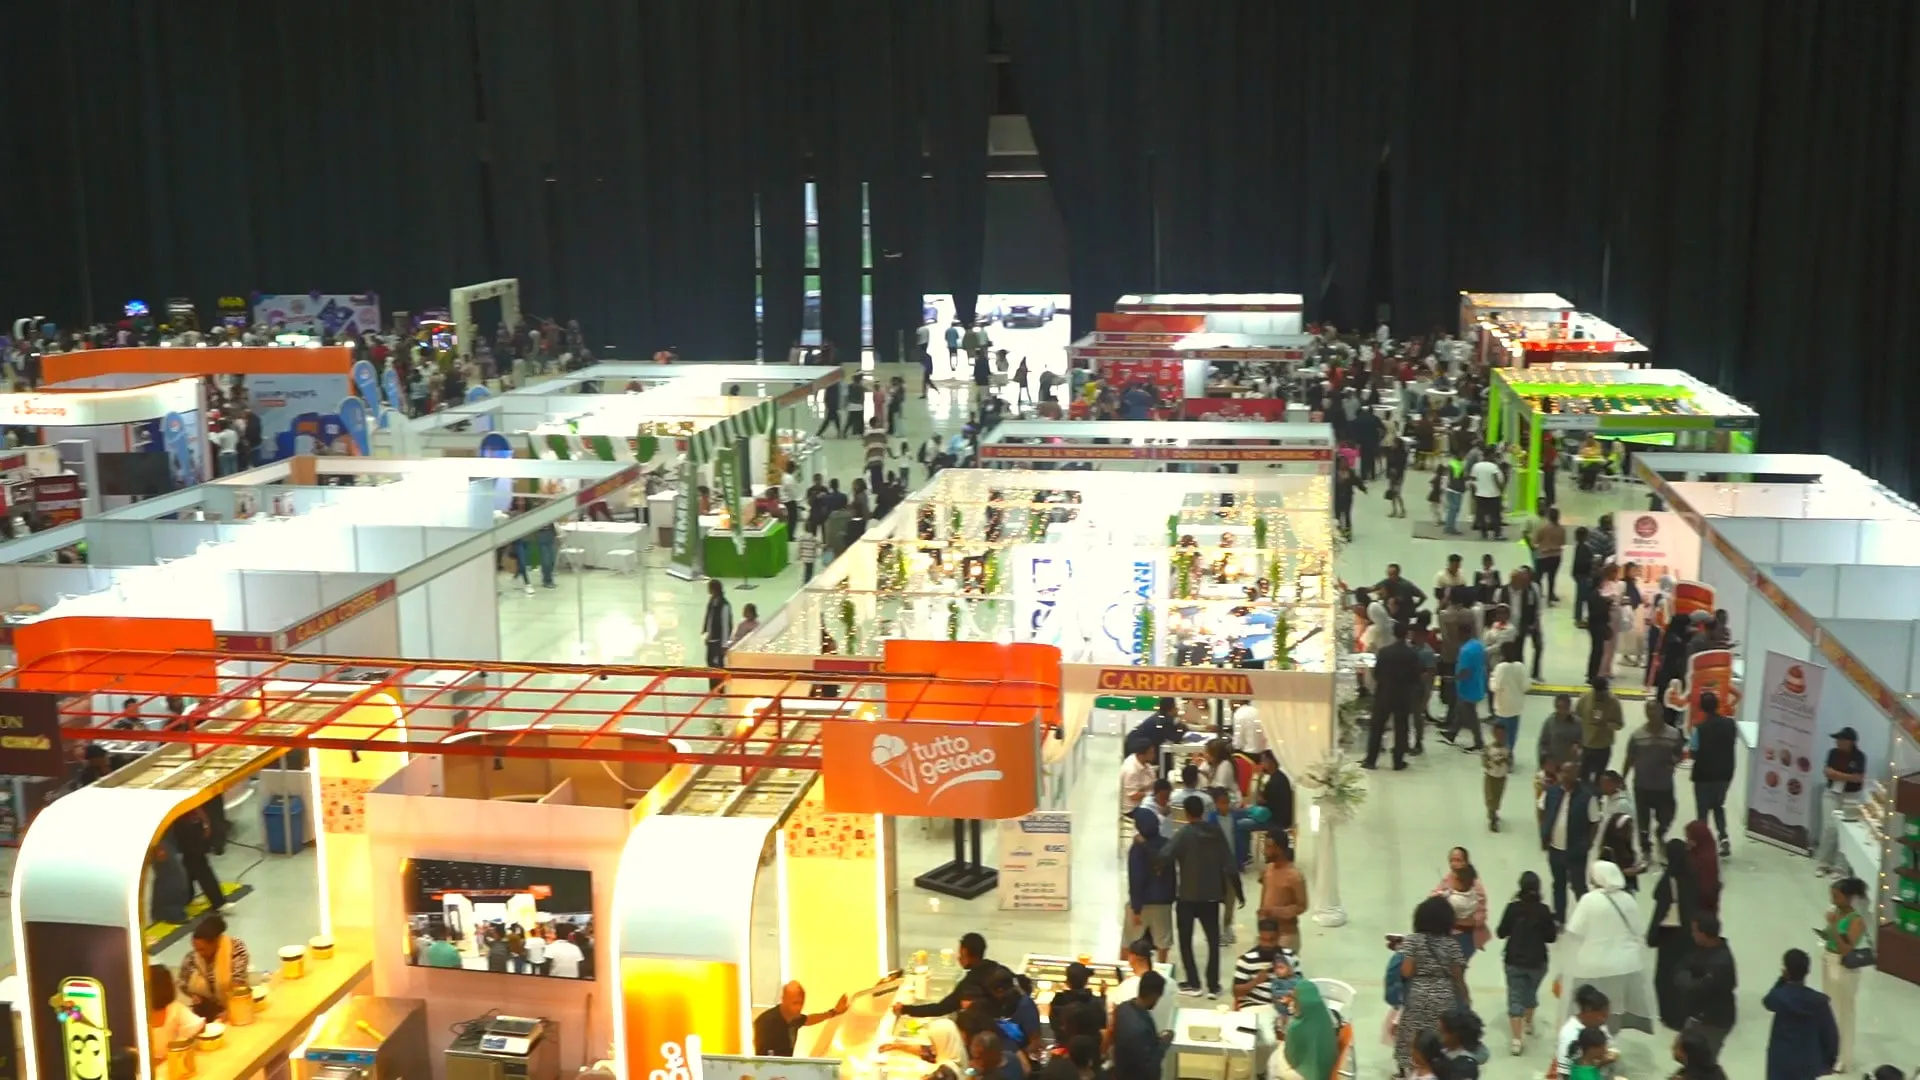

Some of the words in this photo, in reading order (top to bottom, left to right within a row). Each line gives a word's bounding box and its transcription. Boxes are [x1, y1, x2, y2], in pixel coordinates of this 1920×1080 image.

[1102, 671, 1247, 693] CARPIGIANI
[912, 736, 970, 761] tutto
[919, 748, 996, 785] gelato
